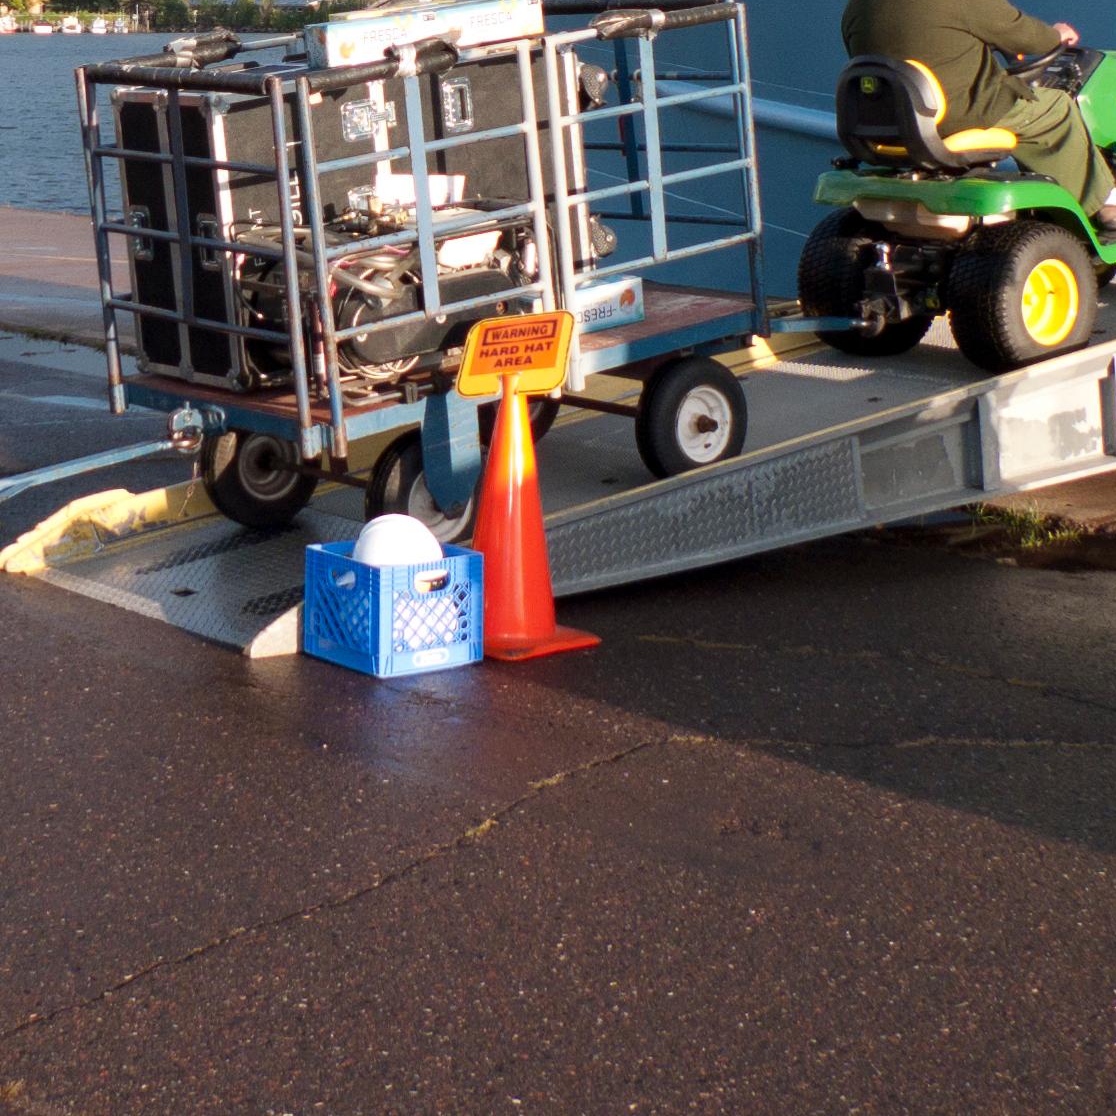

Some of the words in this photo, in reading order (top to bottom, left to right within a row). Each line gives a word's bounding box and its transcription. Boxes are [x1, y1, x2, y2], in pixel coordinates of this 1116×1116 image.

[469, 11, 513, 29] FRESCA
[363, 27, 407, 44] FRESCA
[577, 304, 614, 324] FRESC
[491, 324, 549, 341] WARNING
[480, 345, 519, 358] HARD
[524, 340, 554, 353] HAT
[494, 355, 533, 368] AREA
